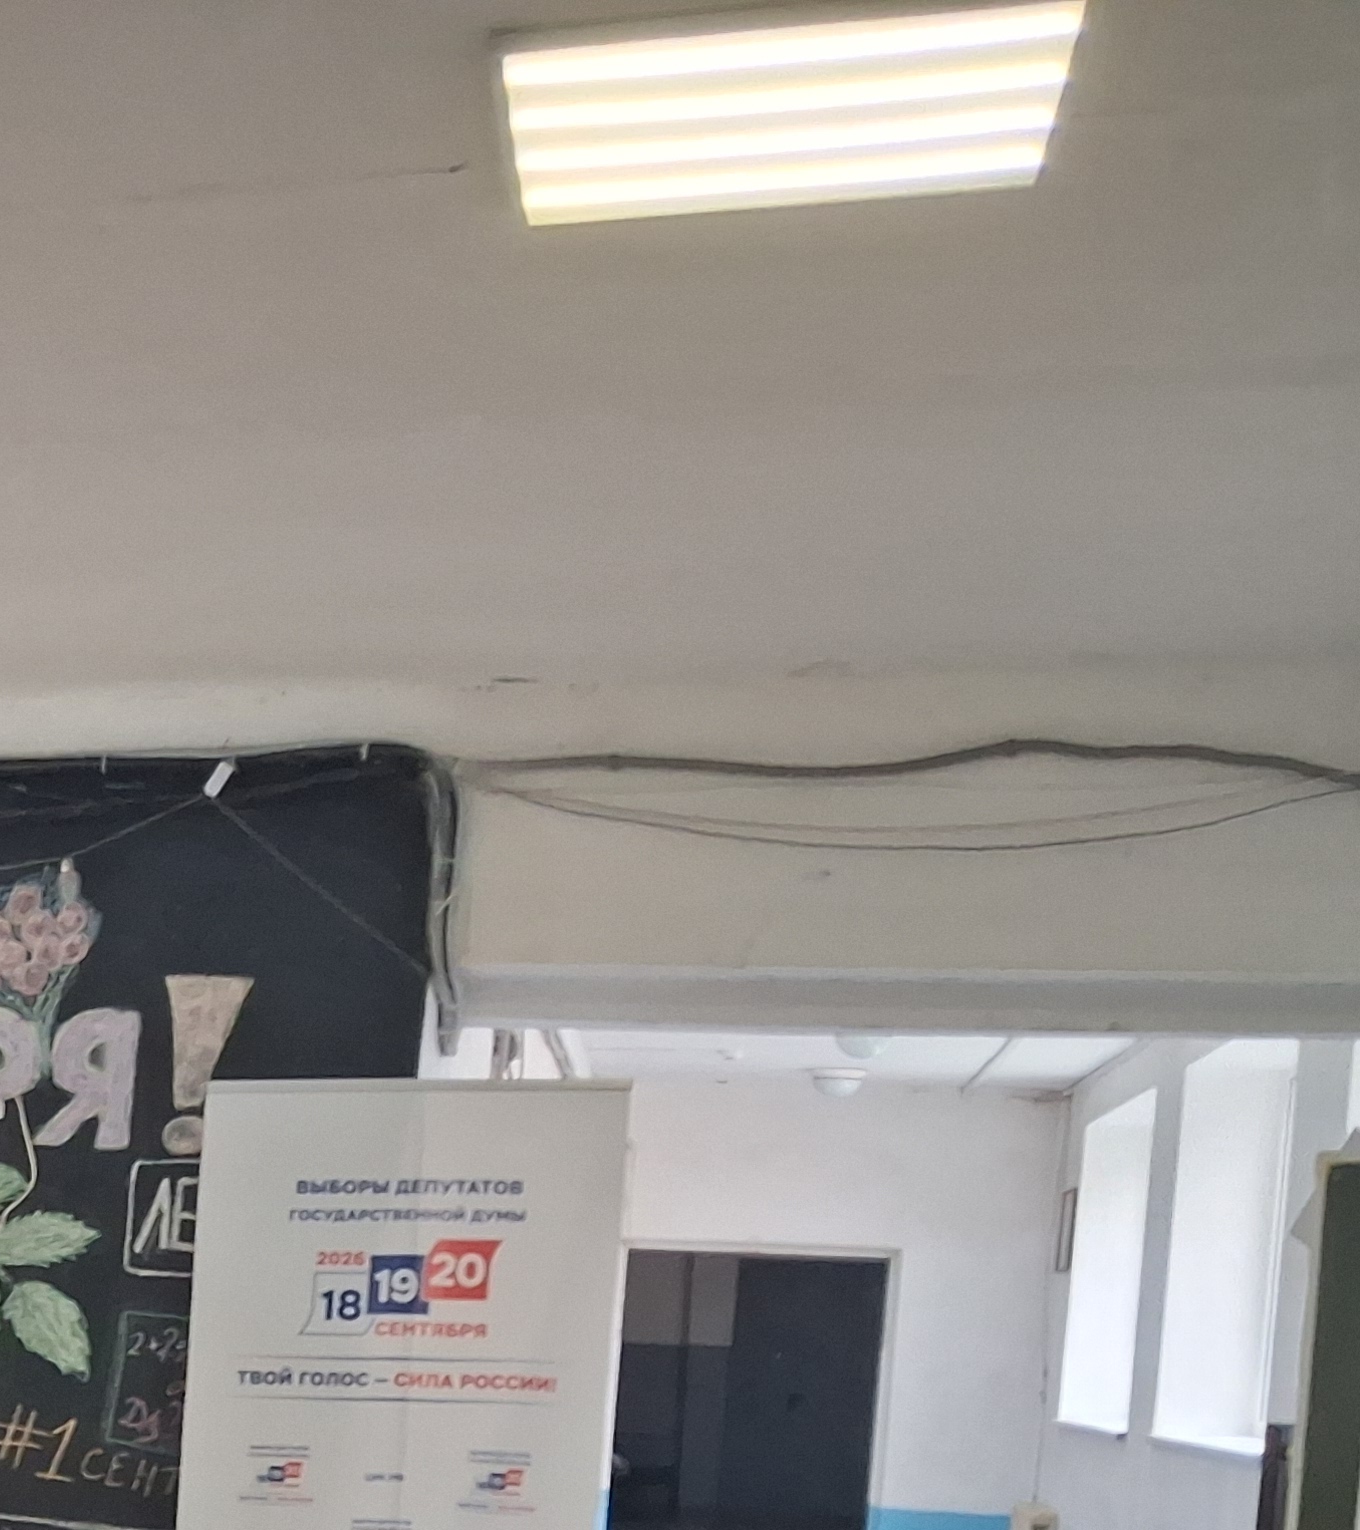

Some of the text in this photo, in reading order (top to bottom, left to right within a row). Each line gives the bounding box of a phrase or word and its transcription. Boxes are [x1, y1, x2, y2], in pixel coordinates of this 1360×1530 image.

[296, 1179, 524, 1196] ВЫБОРЫ ДЕПУТАТОВ
[289, 1207, 526, 1223] ГОСУДАРСТВЕННОЙ ДУМЫ
[316, 1251, 366, 1267] 2026
[321, 1252, 487, 1322] 18 19 20
[375, 1322, 488, 1338] СЕНТЯБРЯ
[237, 1367, 292, 1385] ТВОЙ
[298, 1371, 368, 1387] ГОЛОС
[393, 1372, 452, 1388] СИЛА
